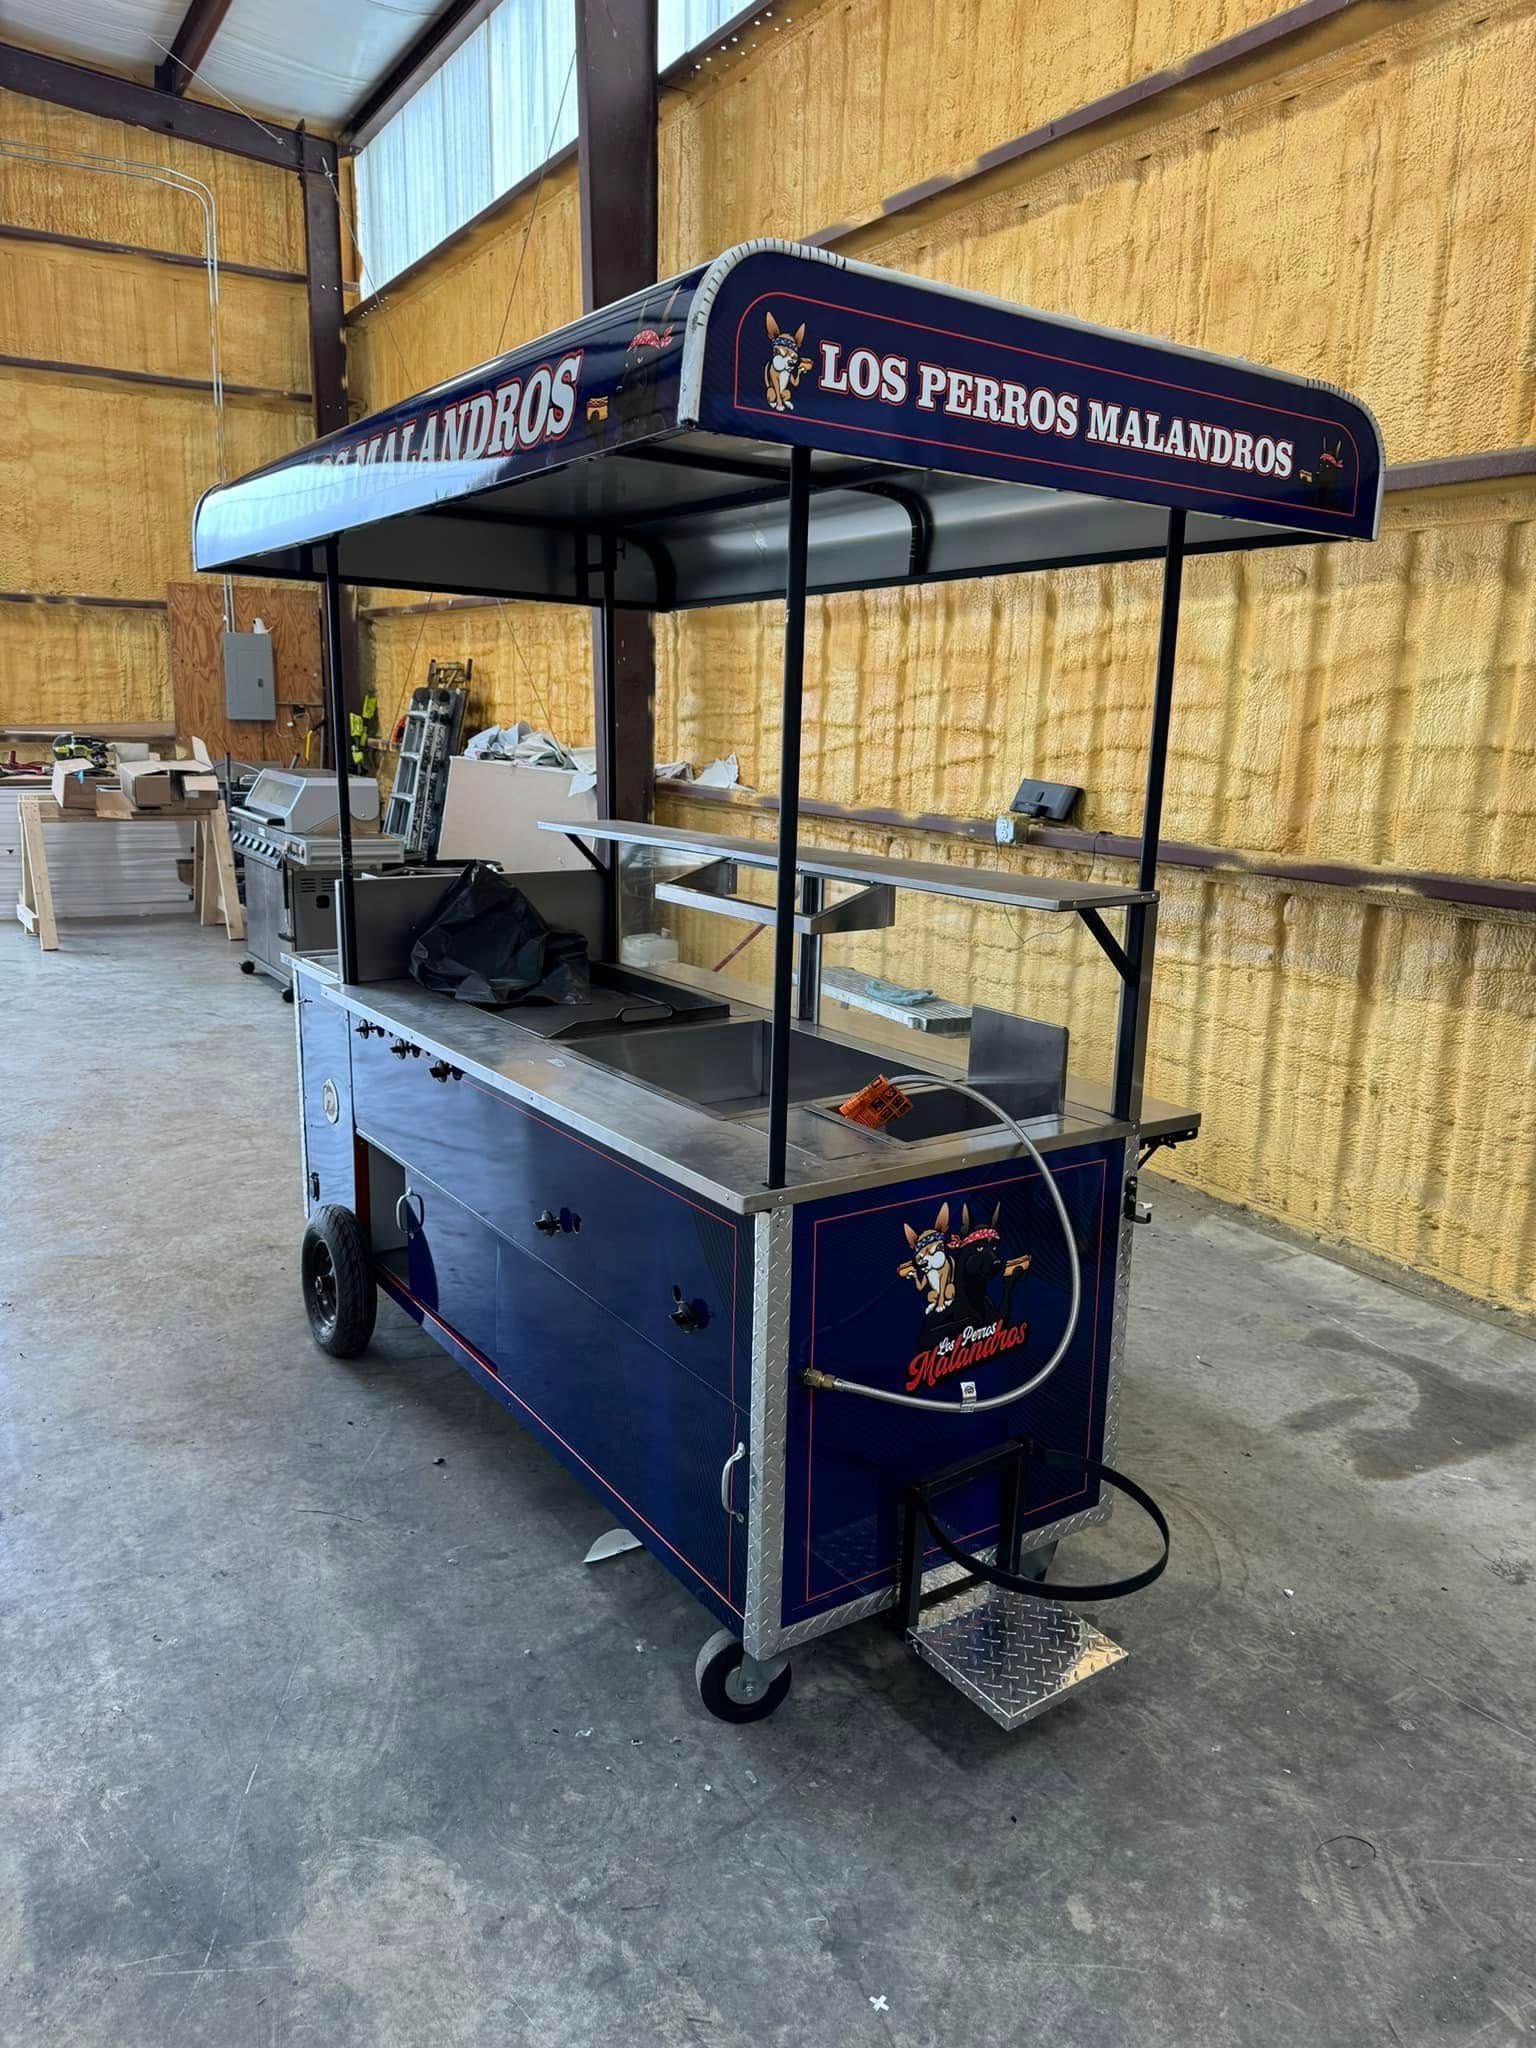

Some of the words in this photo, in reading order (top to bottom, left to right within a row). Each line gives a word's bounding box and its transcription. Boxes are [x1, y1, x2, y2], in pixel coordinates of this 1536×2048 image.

[353, 352, 583, 500] MALANDROS
[819, 341, 908, 404] LOS
[917, 363, 1080, 438] PERROS
[1086, 400, 1294, 479] MALANDROS
[906, 1319, 1028, 1391] Malandros
[937, 1337, 955, 1355] Los
[961, 1322, 997, 1346] Perros
